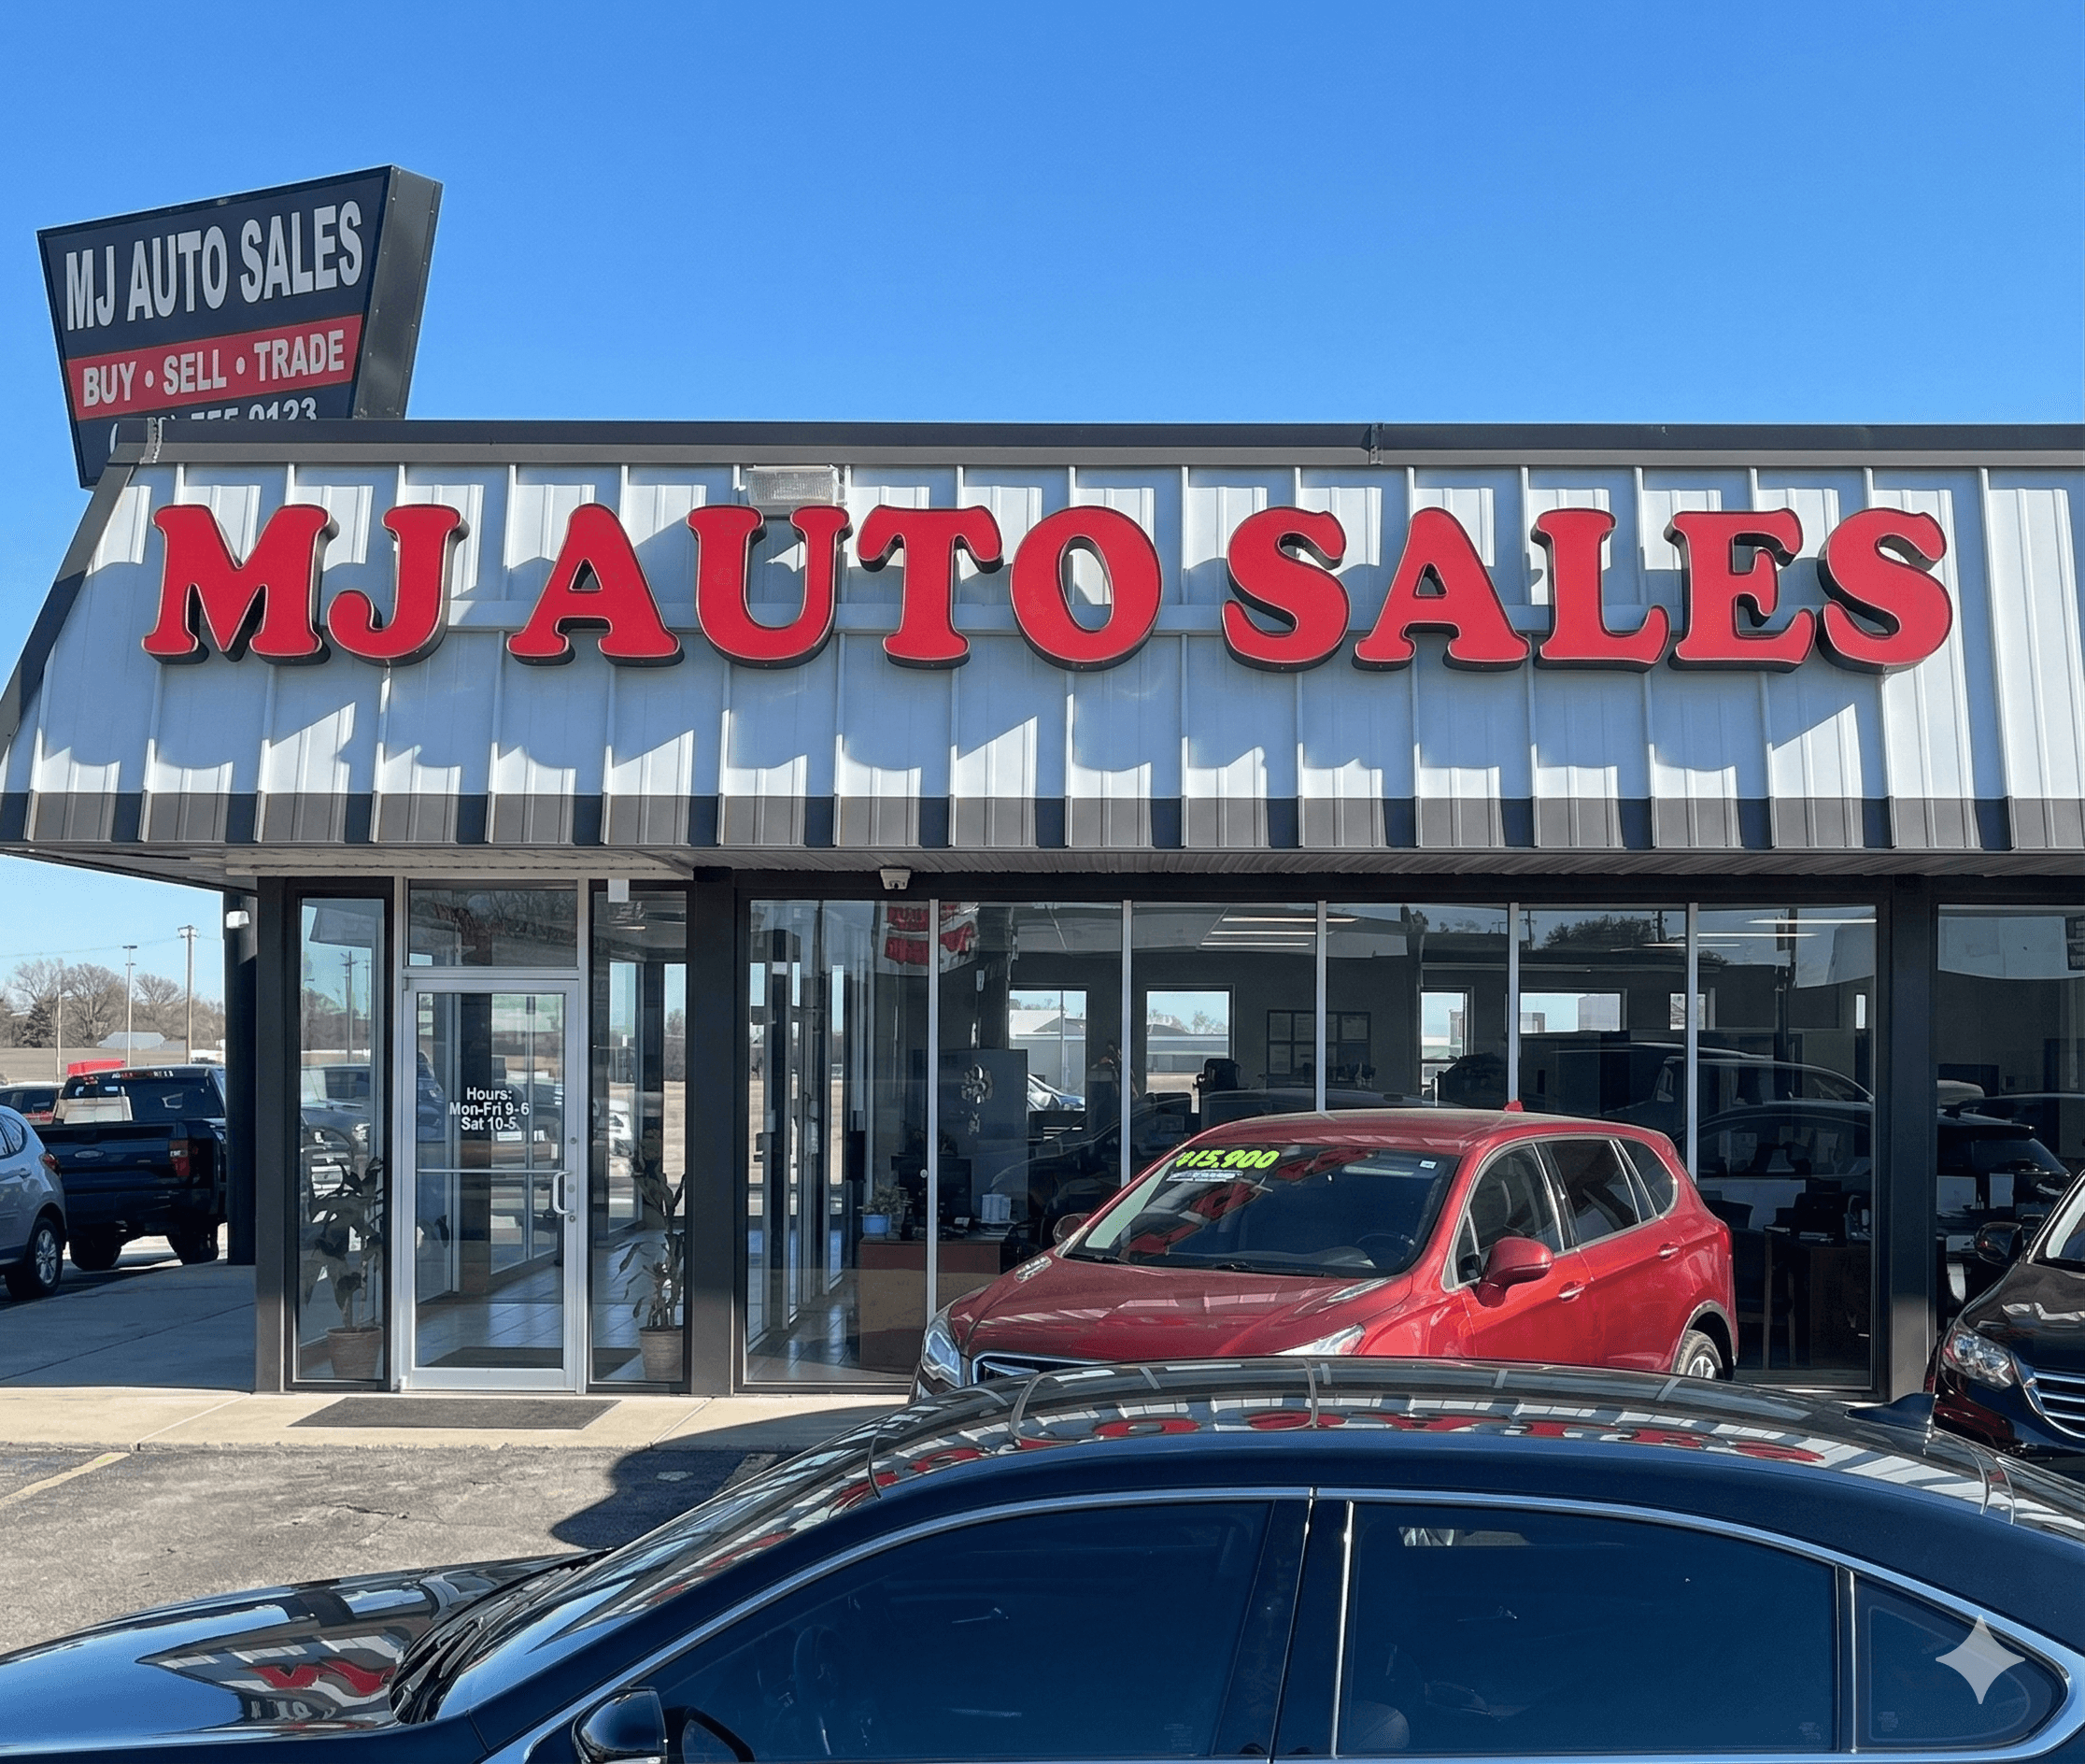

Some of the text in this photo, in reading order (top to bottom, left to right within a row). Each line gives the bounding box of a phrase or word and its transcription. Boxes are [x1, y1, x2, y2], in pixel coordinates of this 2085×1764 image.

[65, 200, 363, 331] MJ AUTO SALES
[83, 329, 345, 407] BUY SELL TRADE
[142, 505, 1952, 669] MJ AUTO SALES
[448, 1102, 502, 1116] Mon-Fri
[466, 1087, 513, 1101] Hours:
[461, 1116, 518, 1131] Sat 10-5
